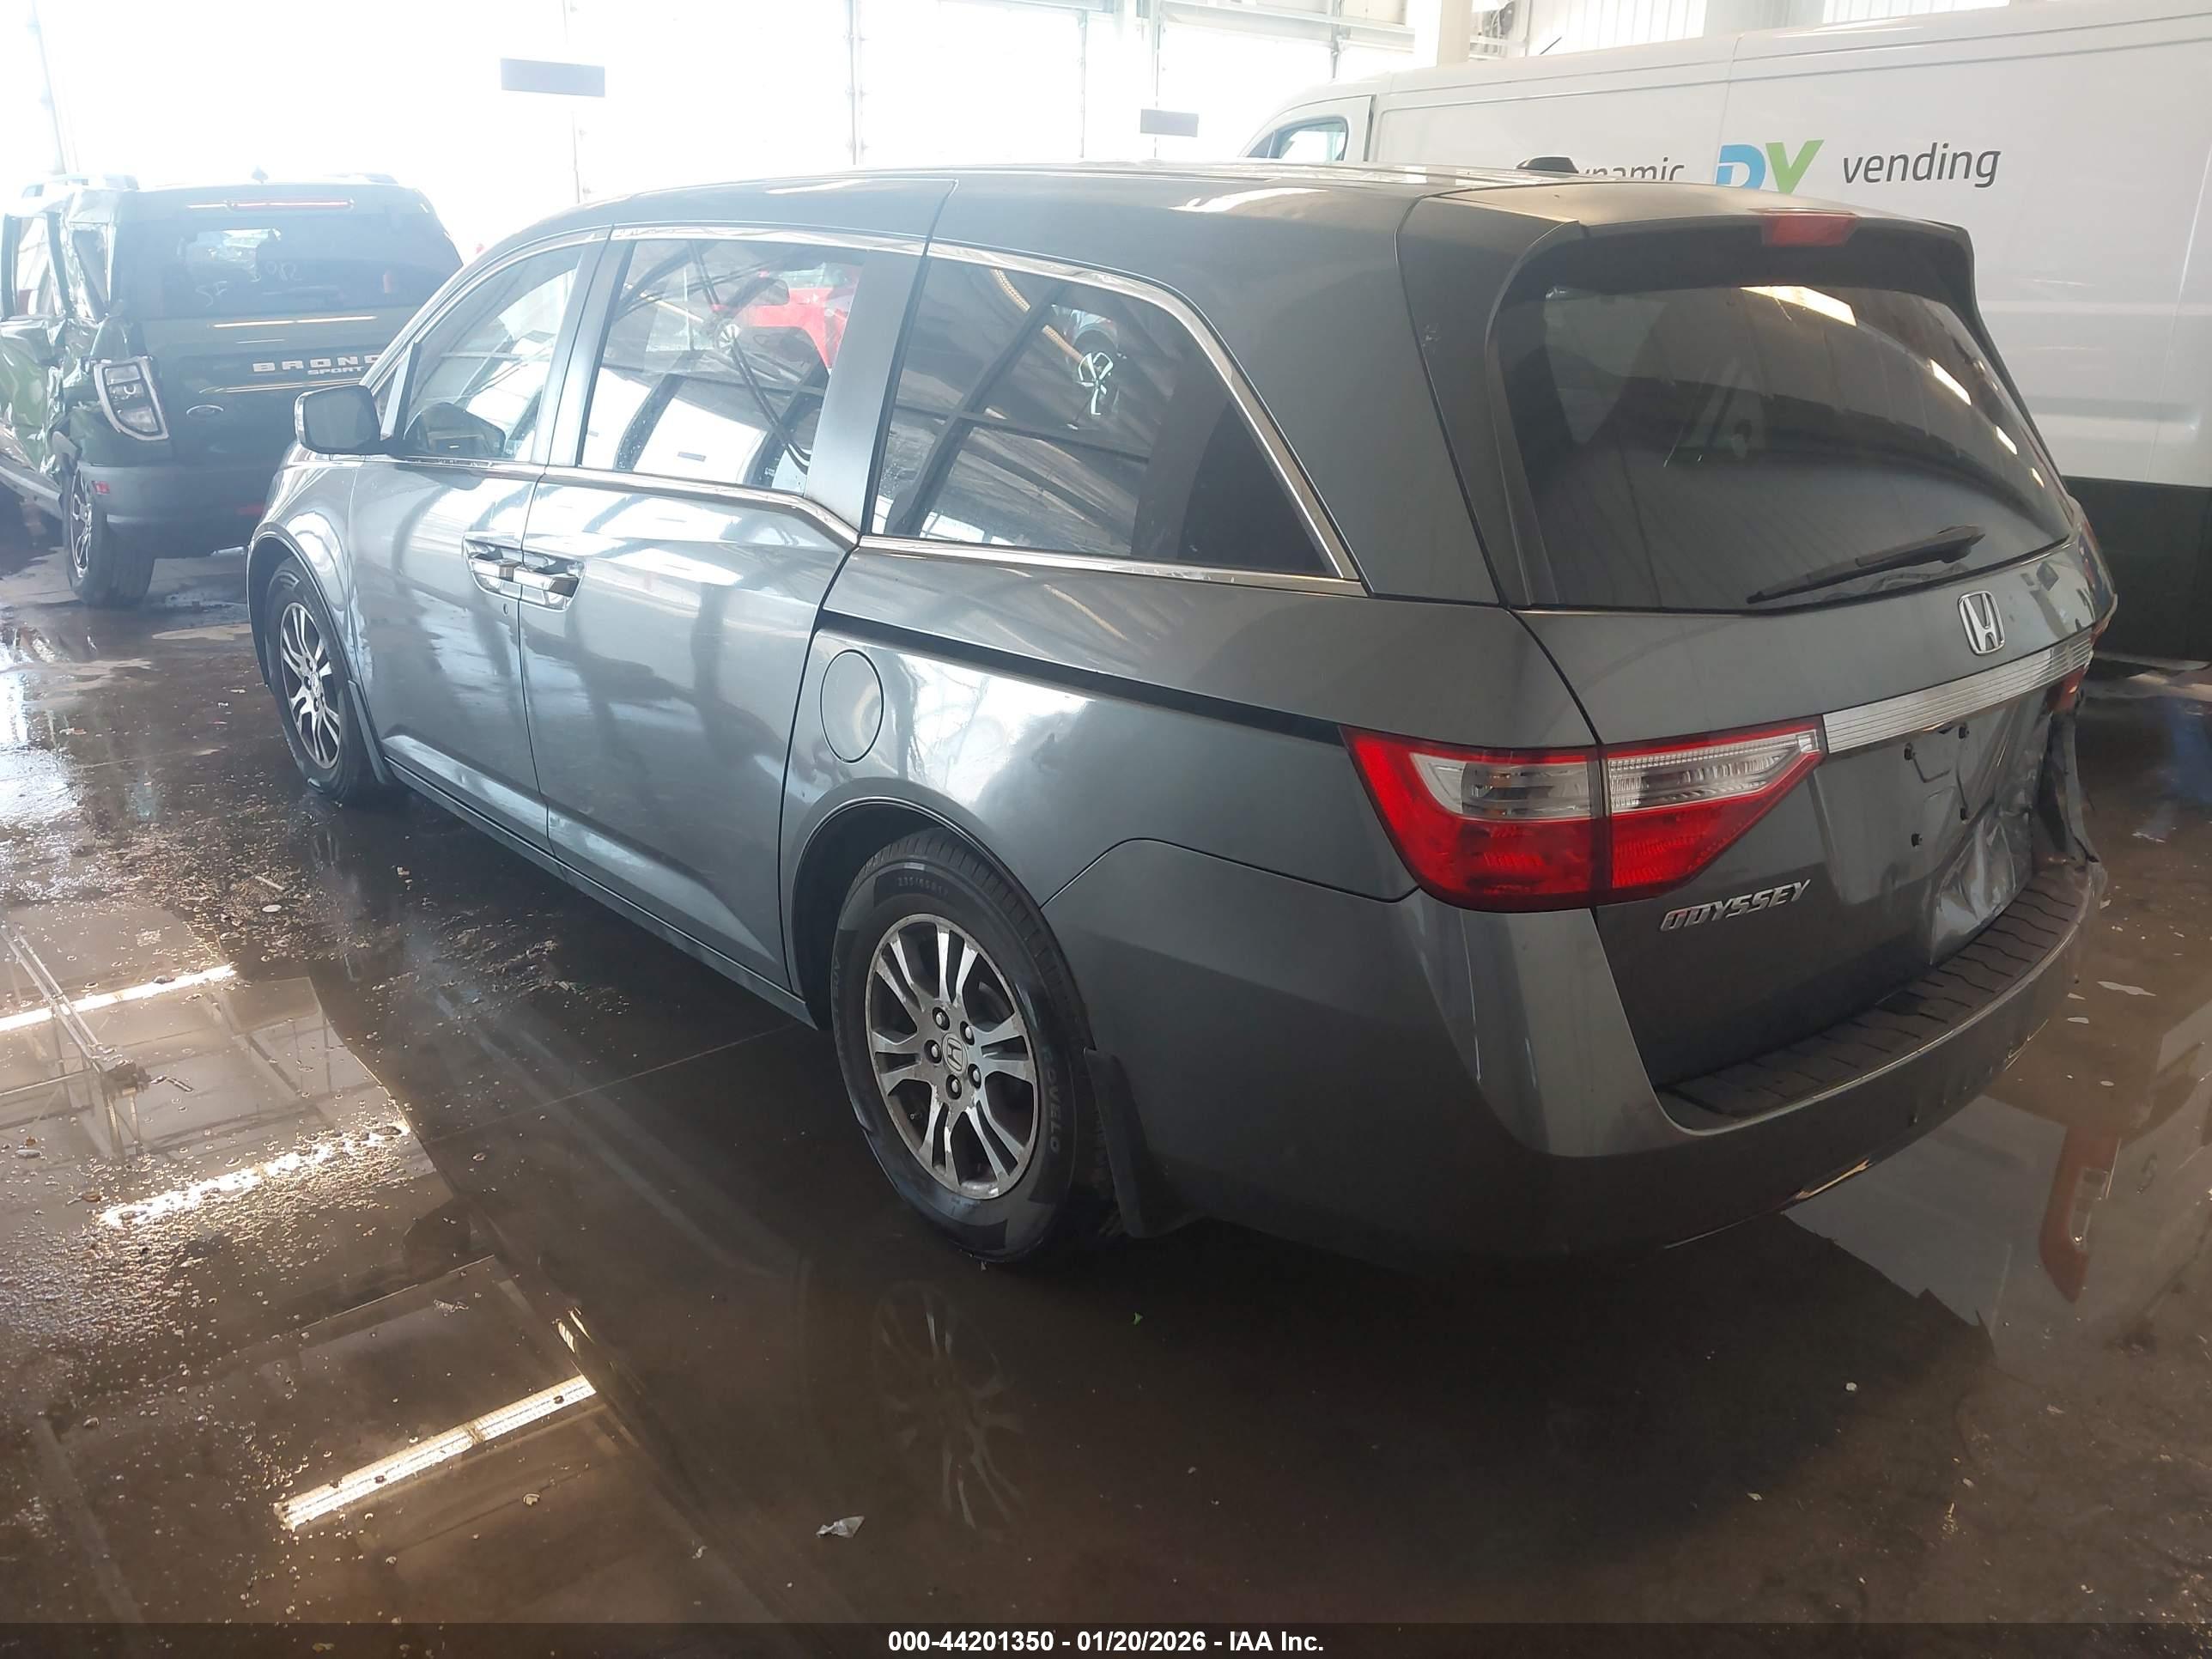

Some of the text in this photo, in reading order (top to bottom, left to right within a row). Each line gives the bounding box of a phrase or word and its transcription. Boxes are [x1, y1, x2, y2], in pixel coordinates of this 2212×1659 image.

[1843, 142, 2001, 187] vending
[252, 354, 382, 373] BRONC
[307, 366, 364, 375] SPORT
[1660, 878, 1810, 932] ODYSSEY
